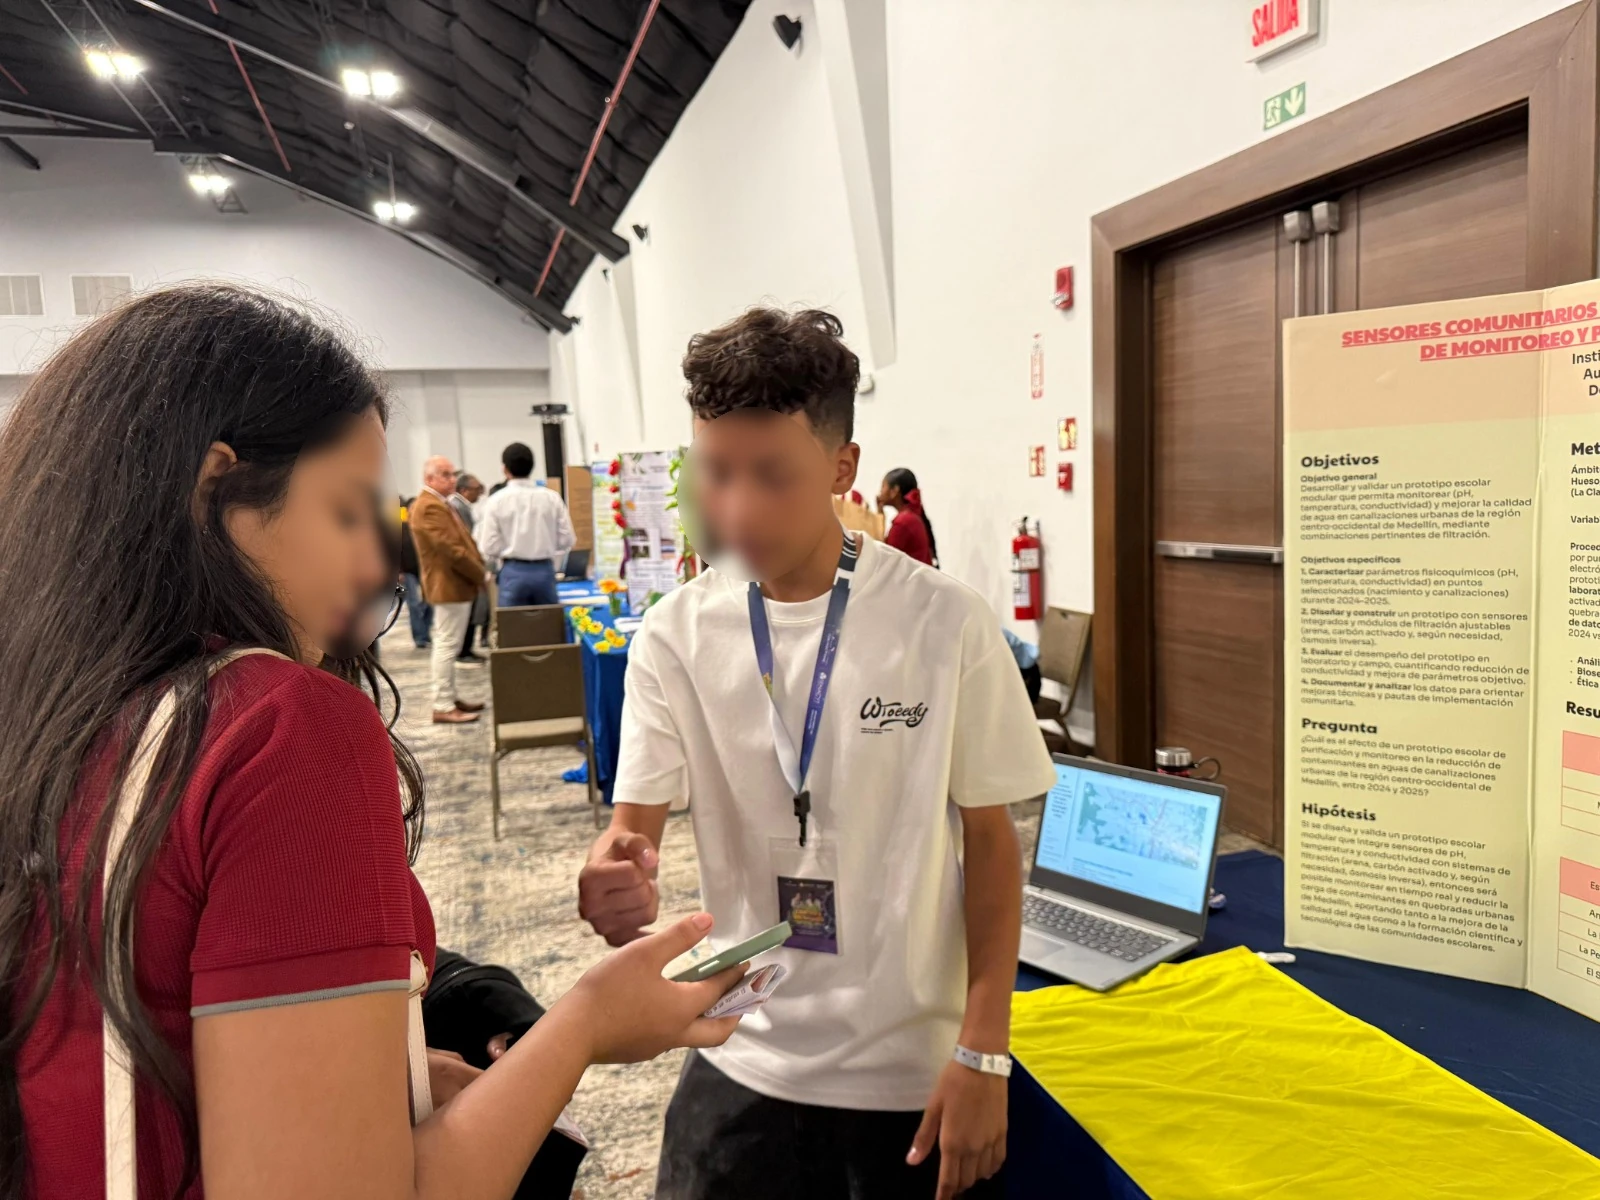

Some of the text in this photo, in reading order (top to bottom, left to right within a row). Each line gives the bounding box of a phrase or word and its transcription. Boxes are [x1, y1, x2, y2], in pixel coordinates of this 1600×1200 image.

[1342, 302, 1598, 346] SENSORES COMUNITARIOS
[1420, 344, 1447, 359] DE
[1451, 330, 1574, 355] MONITOREO
[1577, 327, 1589, 343] Y
[1589, 385, 1600, 396] D
[1301, 453, 1380, 470] Objetivos
[1300, 472, 1377, 484] Objetivo general
[1300, 479, 1491, 492] Desarrollar validar prototipo escolar
[1300, 489, 1474, 502] modular permita monitorear (pH,
[1570, 488, 1584, 498] (La
[1360, 498, 1532, 510] conductividad) mejorar la calidad
[1350, 509, 1520, 520] canalizaciones urbanas de la región
[1442, 520, 1489, 529] mediante
[1300, 530, 1490, 541] combinaciones pertinentes de filtración.
[1301, 556, 1345, 565] Objetivos
[1570, 554, 1585, 563] por
[1309, 567, 1518, 579] Caracterizar parámetros (pH,
[1360, 578, 1482, 588] conductividad) puntos
[1367, 587, 1508, 599] (nacimiento canalizaciones)
[1353, 609, 1395, 617] construir
[1412, 610, 1458, 621] prototipo
[1358, 618, 1511, 631] módulos de filtración ajustables
[1568, 618, 1580, 626] de
[1366, 629, 1503, 641] activado según necesidad,
[1568, 628, 1590, 638] 2024
[1354, 649, 1408, 660] desempeño
[1411, 651, 1425, 660] del
[1428, 653, 1475, 664] prototipo
[1394, 662, 1529, 675] cuantificando reducción de
[1374, 670, 1526, 686] mejora de parámetros objetivo.
[1577, 676, 1599, 688] Ética
[1311, 677, 1524, 698] Documentar analizar los datos para orientar
[1385, 693, 1513, 707] pautas de implementación
[1302, 718, 1378, 734] Pregunta
[1379, 741, 1390, 749] de
[1406, 744, 1452, 756] prototipo
[1455, 748, 1491, 757] escolar
[1493, 750, 1506, 759] de
[1362, 751, 1410, 761] monitoreo
[1436, 757, 1485, 768] reducción
[1488, 761, 1501, 770] de
[1411, 765, 1496, 781] de canalizaciones
[1360, 772, 1492, 792] región de
[1301, 802, 1376, 821] Hipótesis
[1402, 833, 1448, 846] prototipo
[1450, 839, 1486, 850] escolar
[1392, 842, 1447, 855] sensores de
[1432, 859, 1511, 875] con sistemas de
[1408, 867, 1490, 884] activado según
[1430, 881, 1497, 896] entonces será
[1399, 886, 1508, 909] tiempo real reducir la
[1408, 899, 1514, 921] en quebradas urbanas
[1404, 908, 1508, 932] tanto la mejora de la
[1418, 921, 1515, 944] formación científica
[1588, 928, 1597, 938] La
[1447, 938, 1495, 952] escolares.
[1579, 944, 1588, 955] La
[1586, 966, 1594, 977] El
